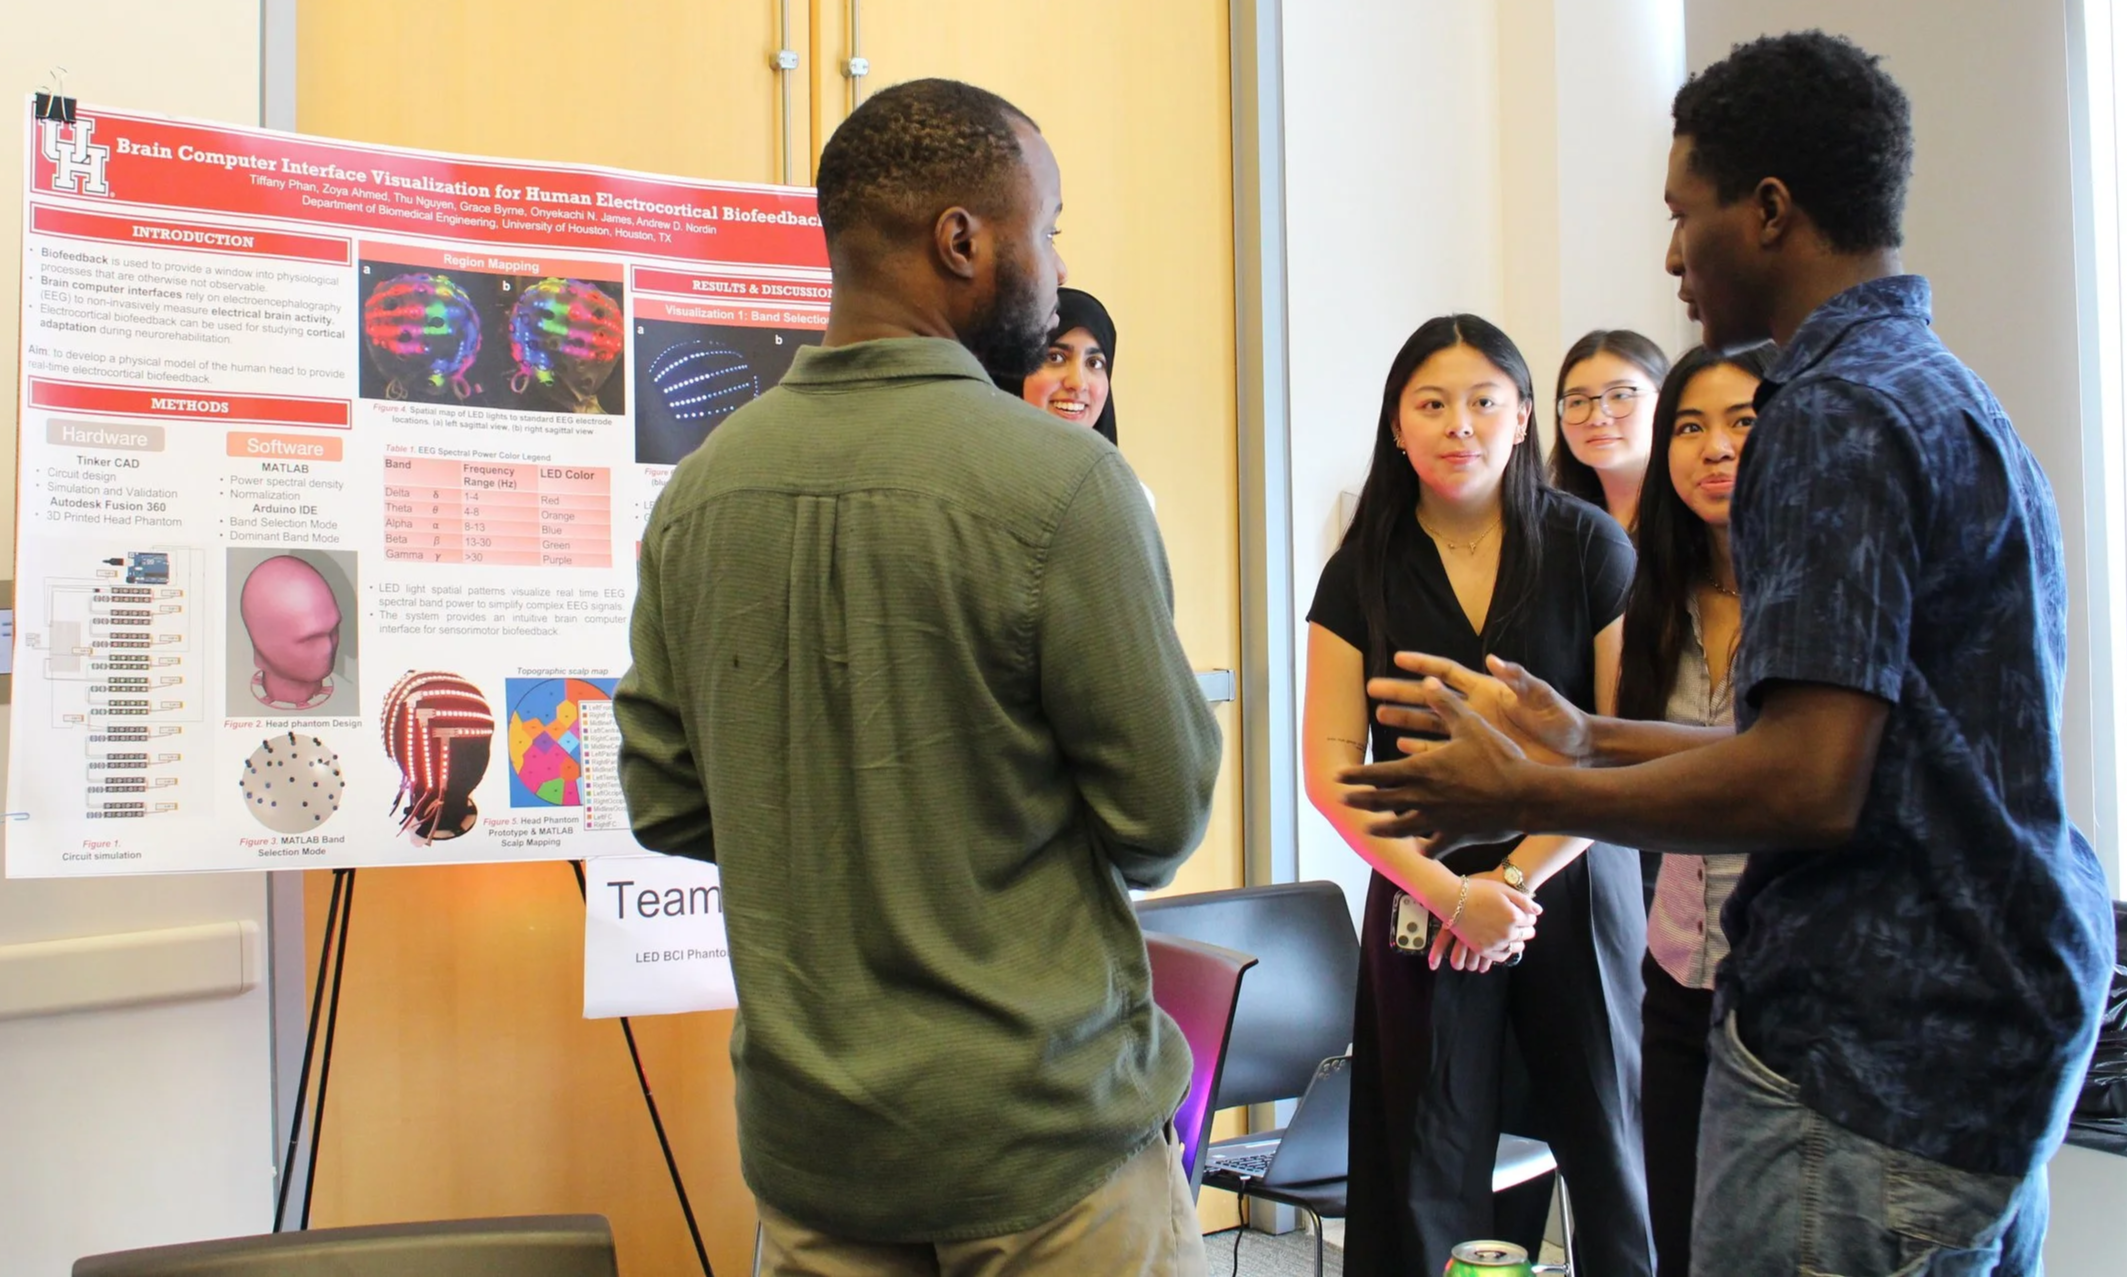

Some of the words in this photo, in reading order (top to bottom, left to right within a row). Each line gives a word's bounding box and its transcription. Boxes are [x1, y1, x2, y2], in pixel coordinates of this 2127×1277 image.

[117, 140, 172, 160] Brain
[177, 148, 276, 173] Computer
[281, 160, 366, 183] Interface
[372, 171, 490, 197] Visualization
[494, 183, 520, 200] for
[525, 187, 591, 207] Human
[596, 194, 717, 218] Electrocortical
[251, 175, 285, 190] Tiffany
[322, 184, 349, 198] Zoya
[395, 194, 413, 205] Thu
[459, 201, 491, 214] Grace
[530, 209, 585, 223] Onyekachi
[635, 219, 671, 231] Andrew
[685, 223, 716, 234] Nordin
[302, 195, 363, 213] Department
[365, 205, 376, 215] of
[378, 206, 433, 222] Biomedical
[501, 220, 553, 236] University
[554, 225, 565, 235] of
[659, 232, 671, 242] TX
[132, 227, 253, 248] INTRODUCTION
[41, 248, 108, 263] Biofeedback
[111, 254, 120, 264] is
[123, 257, 148, 267] used
[151, 258, 161, 268] to
[164, 261, 202, 272] provide
[205, 265, 211, 273] a
[215, 265, 252, 277] window
[255, 268, 274, 279] into
[277, 270, 338, 285] physiological
[363, 265, 371, 274] a
[443, 253, 485, 269] Region
[487, 257, 539, 274] Mapping
[40, 264, 92, 276] processes
[95, 267, 115, 278] that
[117, 271, 135, 280] are
[137, 272, 187, 285] otherwise
[190, 277, 207, 286] not
[209, 278, 270, 292] observable.
[502, 280, 511, 291] b
[692, 279, 746, 293] RESULTS
[749, 283, 758, 293] &
[40, 275, 69, 287] Brain
[71, 280, 124, 292] computer
[127, 283, 182, 297] interfaces
[185, 288, 204, 301] rely
[207, 292, 219, 300] on
[223, 291, 340, 312] electroencephalography
[41, 290, 71, 304] (EEG)
[74, 293, 83, 303] to
[87, 296, 159, 312] non-invasively
[163, 303, 208, 314] measure
[211, 305, 261, 318] electrical
[264, 309, 292, 321] brain
[294, 313, 336, 326] activity.
[665, 305, 734, 318] Visualization
[738, 309, 750, 319] 1:
[750, 310, 780, 321] Band
[783, 311, 828, 323] Selectio
[637, 325, 645, 334] a
[775, 335, 784, 345] b
[151, 397, 228, 412] METHODS
[62, 426, 147, 446] Hardware
[247, 438, 323, 456] Software
[77, 456, 110, 467] Tinker
[114, 457, 139, 468] CAD
[261, 463, 308, 473] MATLAB
[385, 459, 411, 469] Band
[47, 468, 79, 479] Circuit
[81, 469, 116, 483] design
[463, 464, 514, 477] Frequency
[540, 469, 562, 479] LED
[565, 469, 594, 479] Color
[229, 476, 263, 486] Power
[266, 478, 306, 489] spectral
[308, 478, 343, 491] density
[463, 477, 495, 490] Range
[497, 478, 517, 490] (Hz)
[47, 482, 100, 494] Simulation
[103, 485, 123, 495] and
[126, 486, 177, 498] Validation
[229, 490, 300, 501] Normalization
[386, 488, 409, 497] Delta
[50, 497, 101, 509] Autodesk
[104, 499, 143, 511] Fusion
[146, 501, 166, 512] 360
[541, 496, 559, 505] Red
[252, 504, 296, 515] Arduino
[299, 505, 317, 515] IDE
[386, 504, 412, 513] Theta
[464, 508, 479, 516] 4-8
[47, 511, 61, 521] 3D
[63, 512, 100, 523] Printed
[103, 514, 132, 524] Head
[134, 515, 182, 526] Phantom
[229, 517, 257, 527] Band
[260, 518, 307, 529] Selection
[309, 519, 337, 529] Mode
[541, 512, 574, 522] Orange
[386, 519, 412, 530] Alpha
[465, 523, 485, 531] 8-13
[542, 526, 562, 534] Blue
[229, 531, 280, 542] Dominant
[282, 532, 309, 542] Band
[311, 533, 339, 543] Mode
[386, 535, 408, 544] Beta
[466, 538, 491, 547] 13-30
[543, 541, 570, 550] Green
[386, 550, 423, 559] Gamma
[465, 554, 482, 562] >30
[543, 556, 572, 566] Purple
[223, 720, 253, 731] Figure
[265, 719, 289, 728] Head
[290, 719, 330, 730] phantom
[332, 719, 362, 730] Design
[82, 839, 111, 850] Figure
[239, 837, 268, 848] Figure
[280, 835, 319, 845] MATLAB
[321, 834, 344, 844] Band
[62, 851, 92, 861] Circuit
[94, 851, 141, 860] simulation
[258, 848, 299, 857] Selection
[301, 846, 326, 856] Mode
[608, 881, 724, 919] Team
[635, 951, 659, 963] LED
[663, 949, 683, 961] BCI
[687, 947, 731, 960] Phanto
